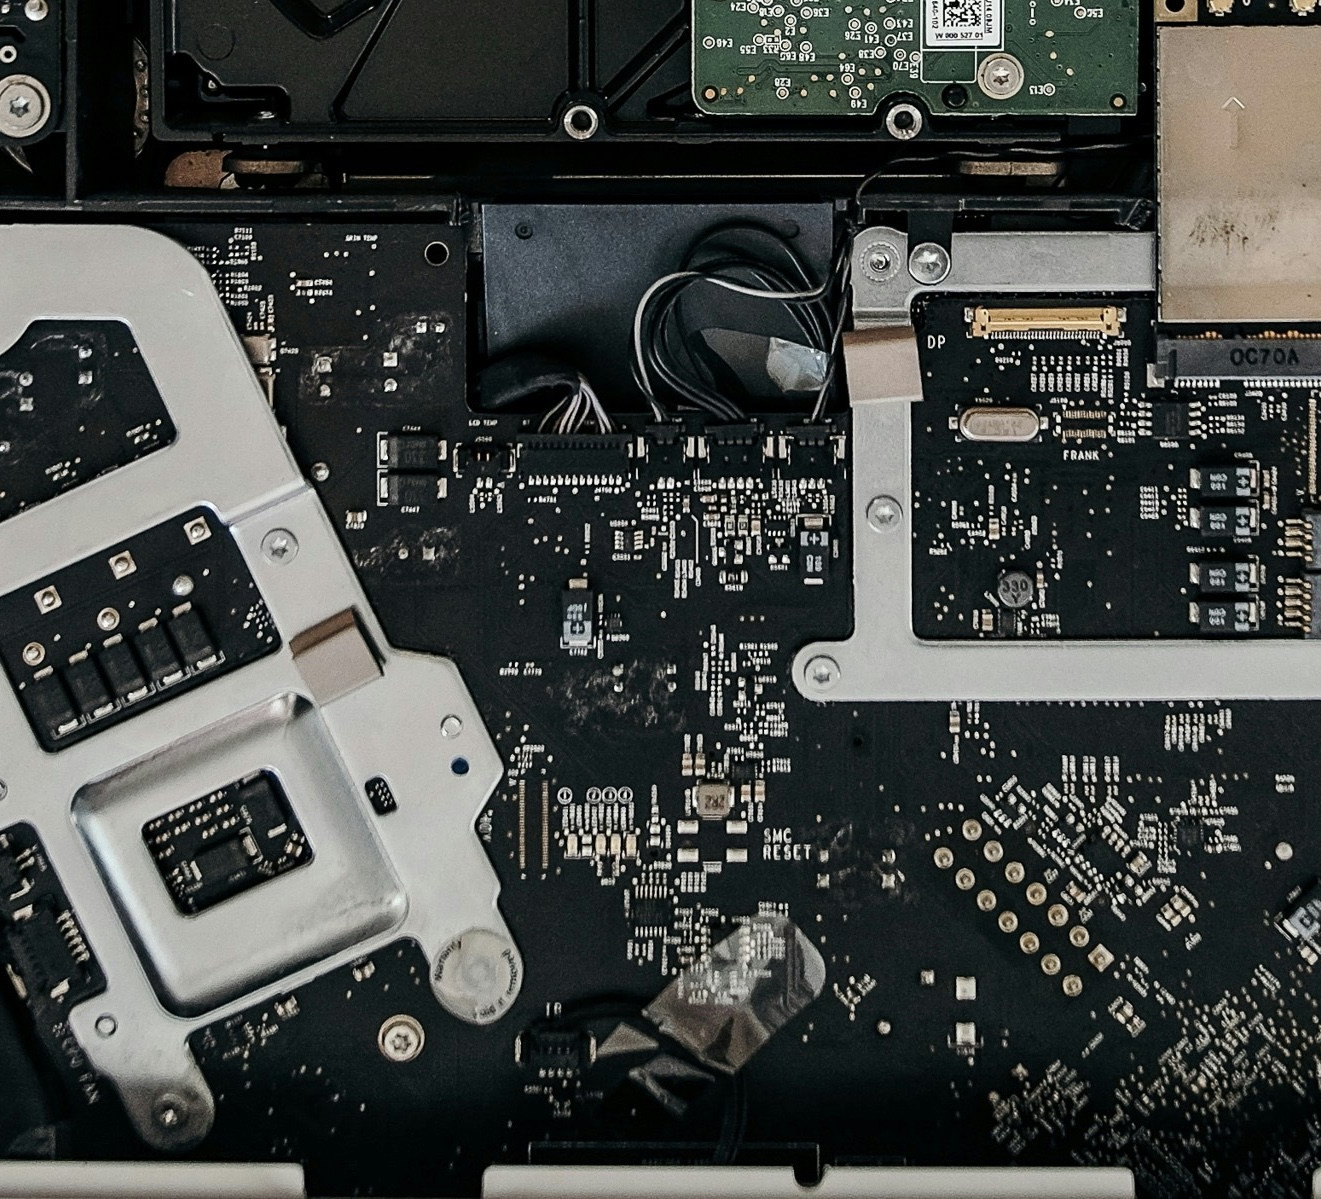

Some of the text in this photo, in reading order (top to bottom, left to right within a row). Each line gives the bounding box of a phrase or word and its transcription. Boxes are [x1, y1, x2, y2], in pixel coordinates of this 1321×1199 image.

[731, 2, 746, 10] E24
[785, 27, 795, 35] E2
[839, 63, 855, 71] E64
[775, 78, 790, 86] E28
[1029, 86, 1044, 94] E13
[928, 335, 945, 349] DP
[1063, 450, 1099, 461] FRANK
[764, 828, 792, 844] SMC
[763, 844, 811, 860] RESET
